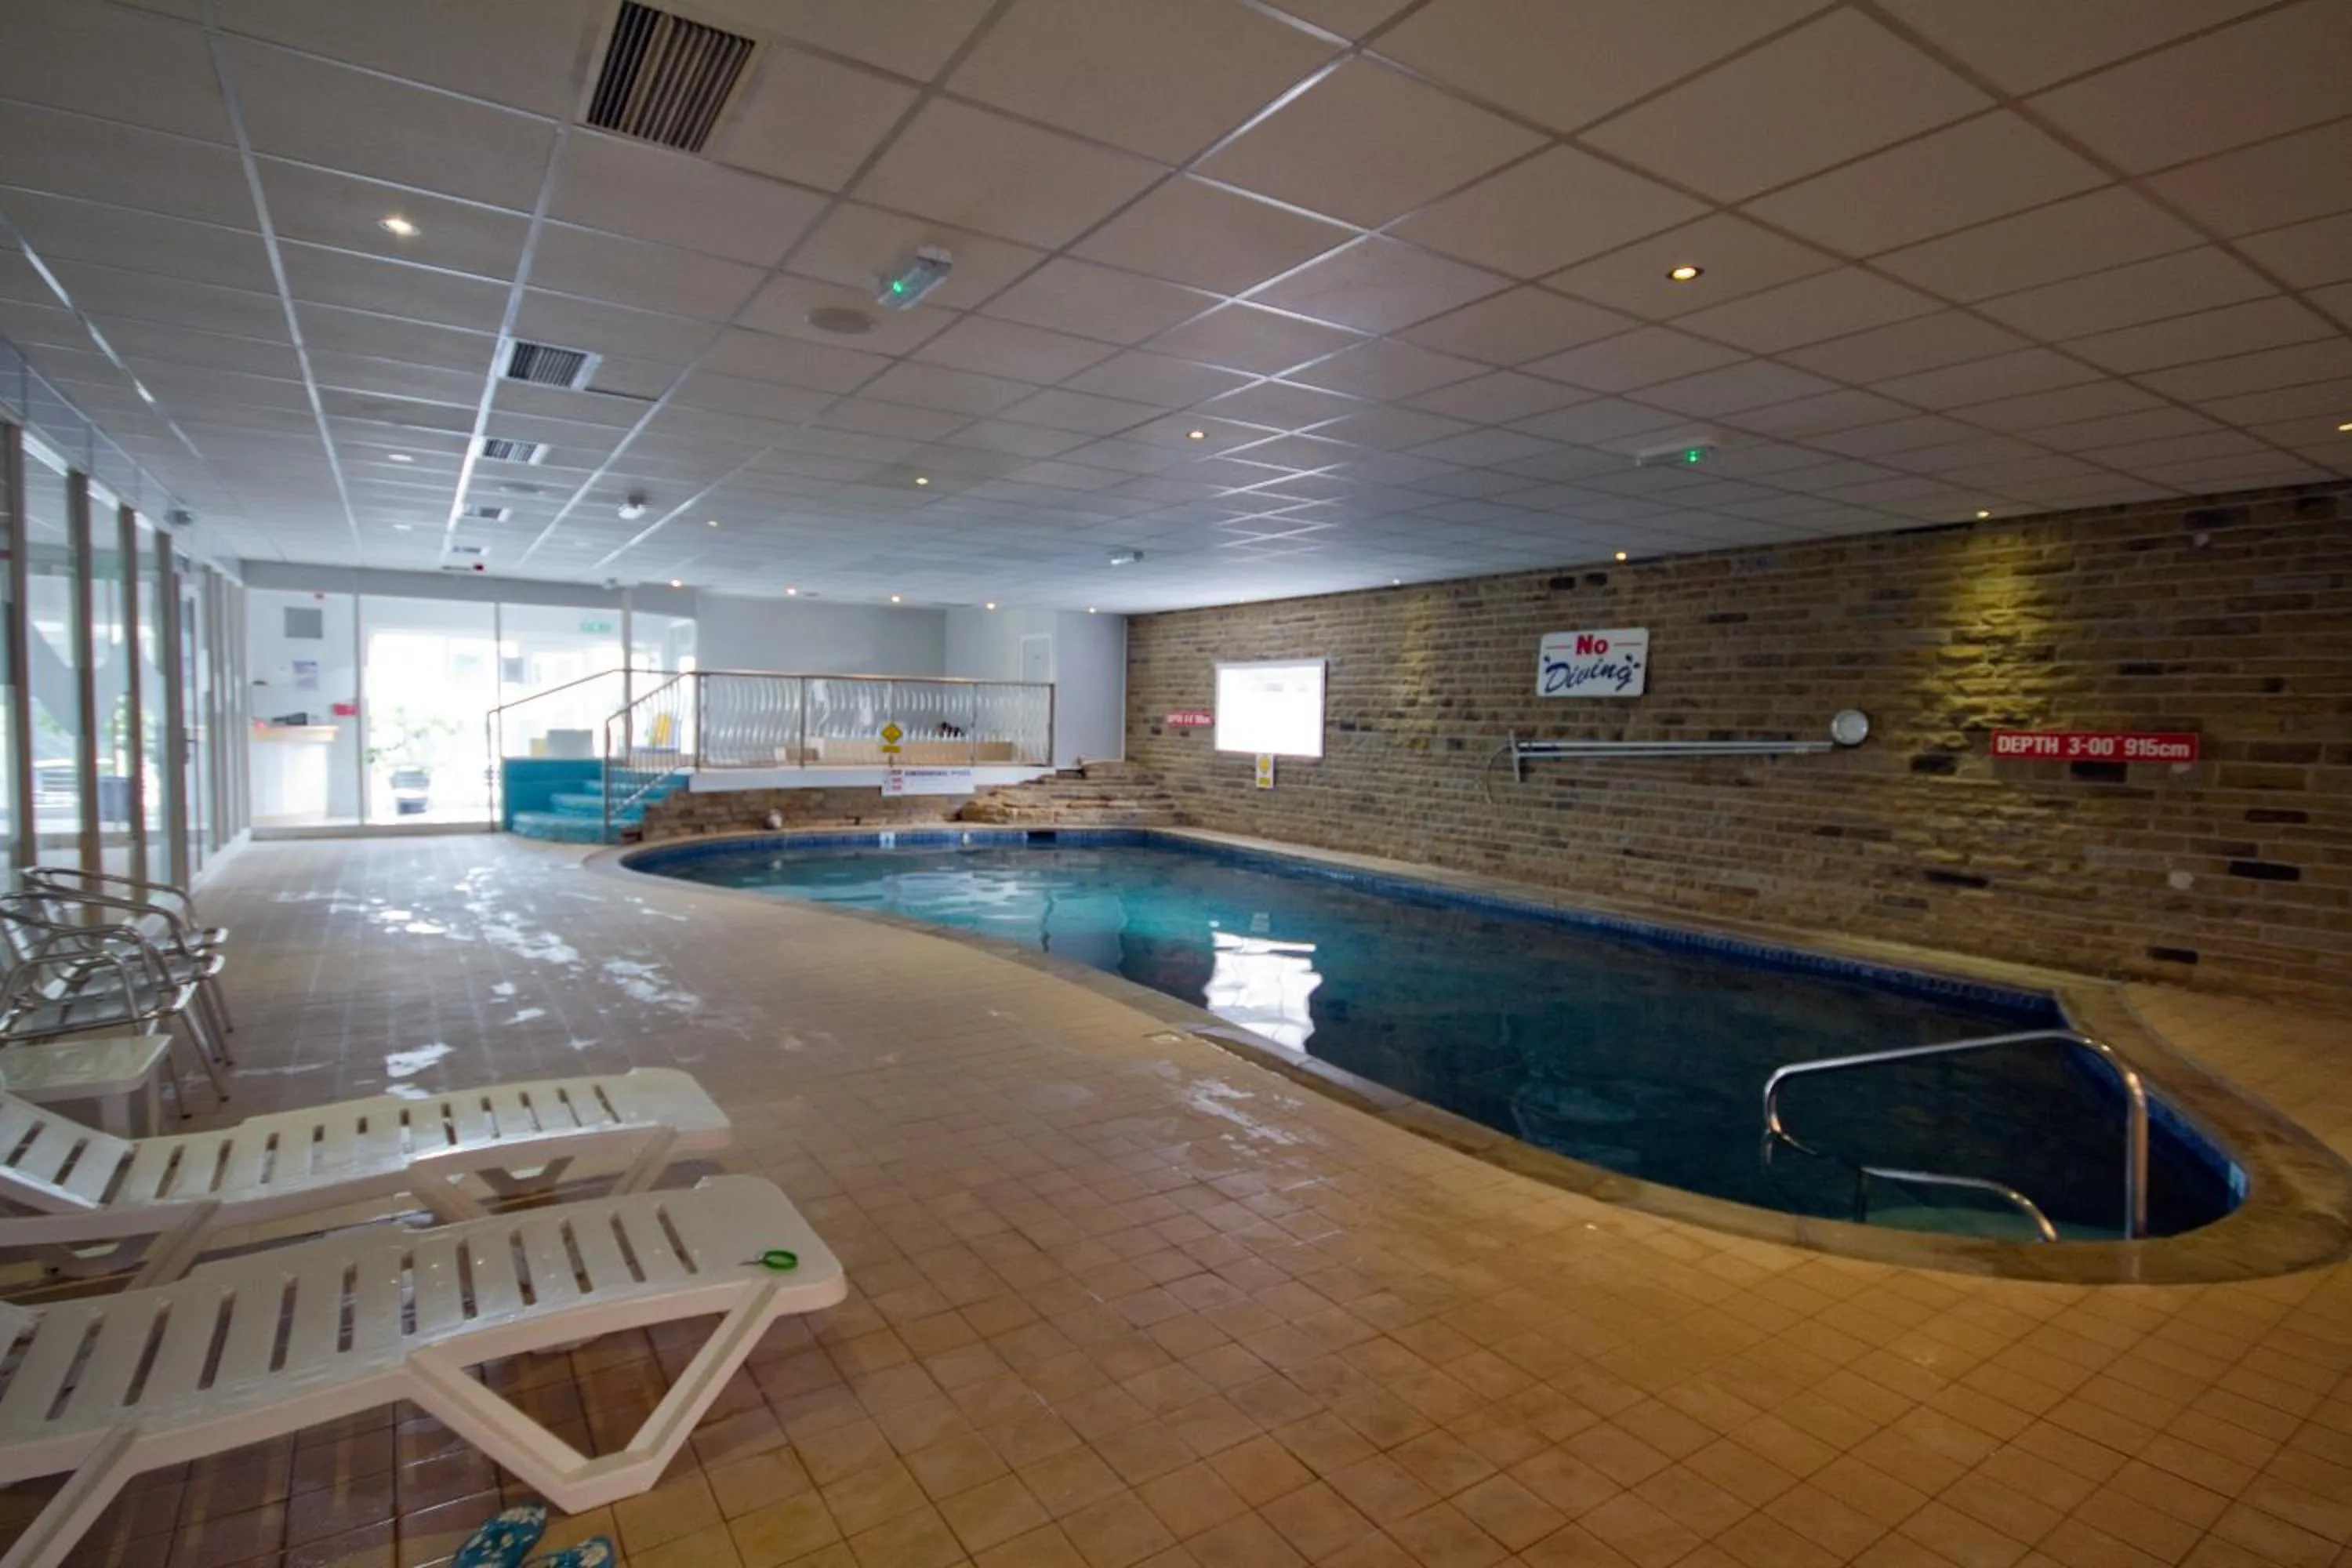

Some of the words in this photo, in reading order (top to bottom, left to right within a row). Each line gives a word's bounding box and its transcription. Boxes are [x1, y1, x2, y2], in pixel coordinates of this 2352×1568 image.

[1576, 633, 1609, 655] No
[1544, 657, 1634, 693] Diving
[1997, 735, 2059, 754] DEPTH
[2124, 738, 2190, 757] 915cm
